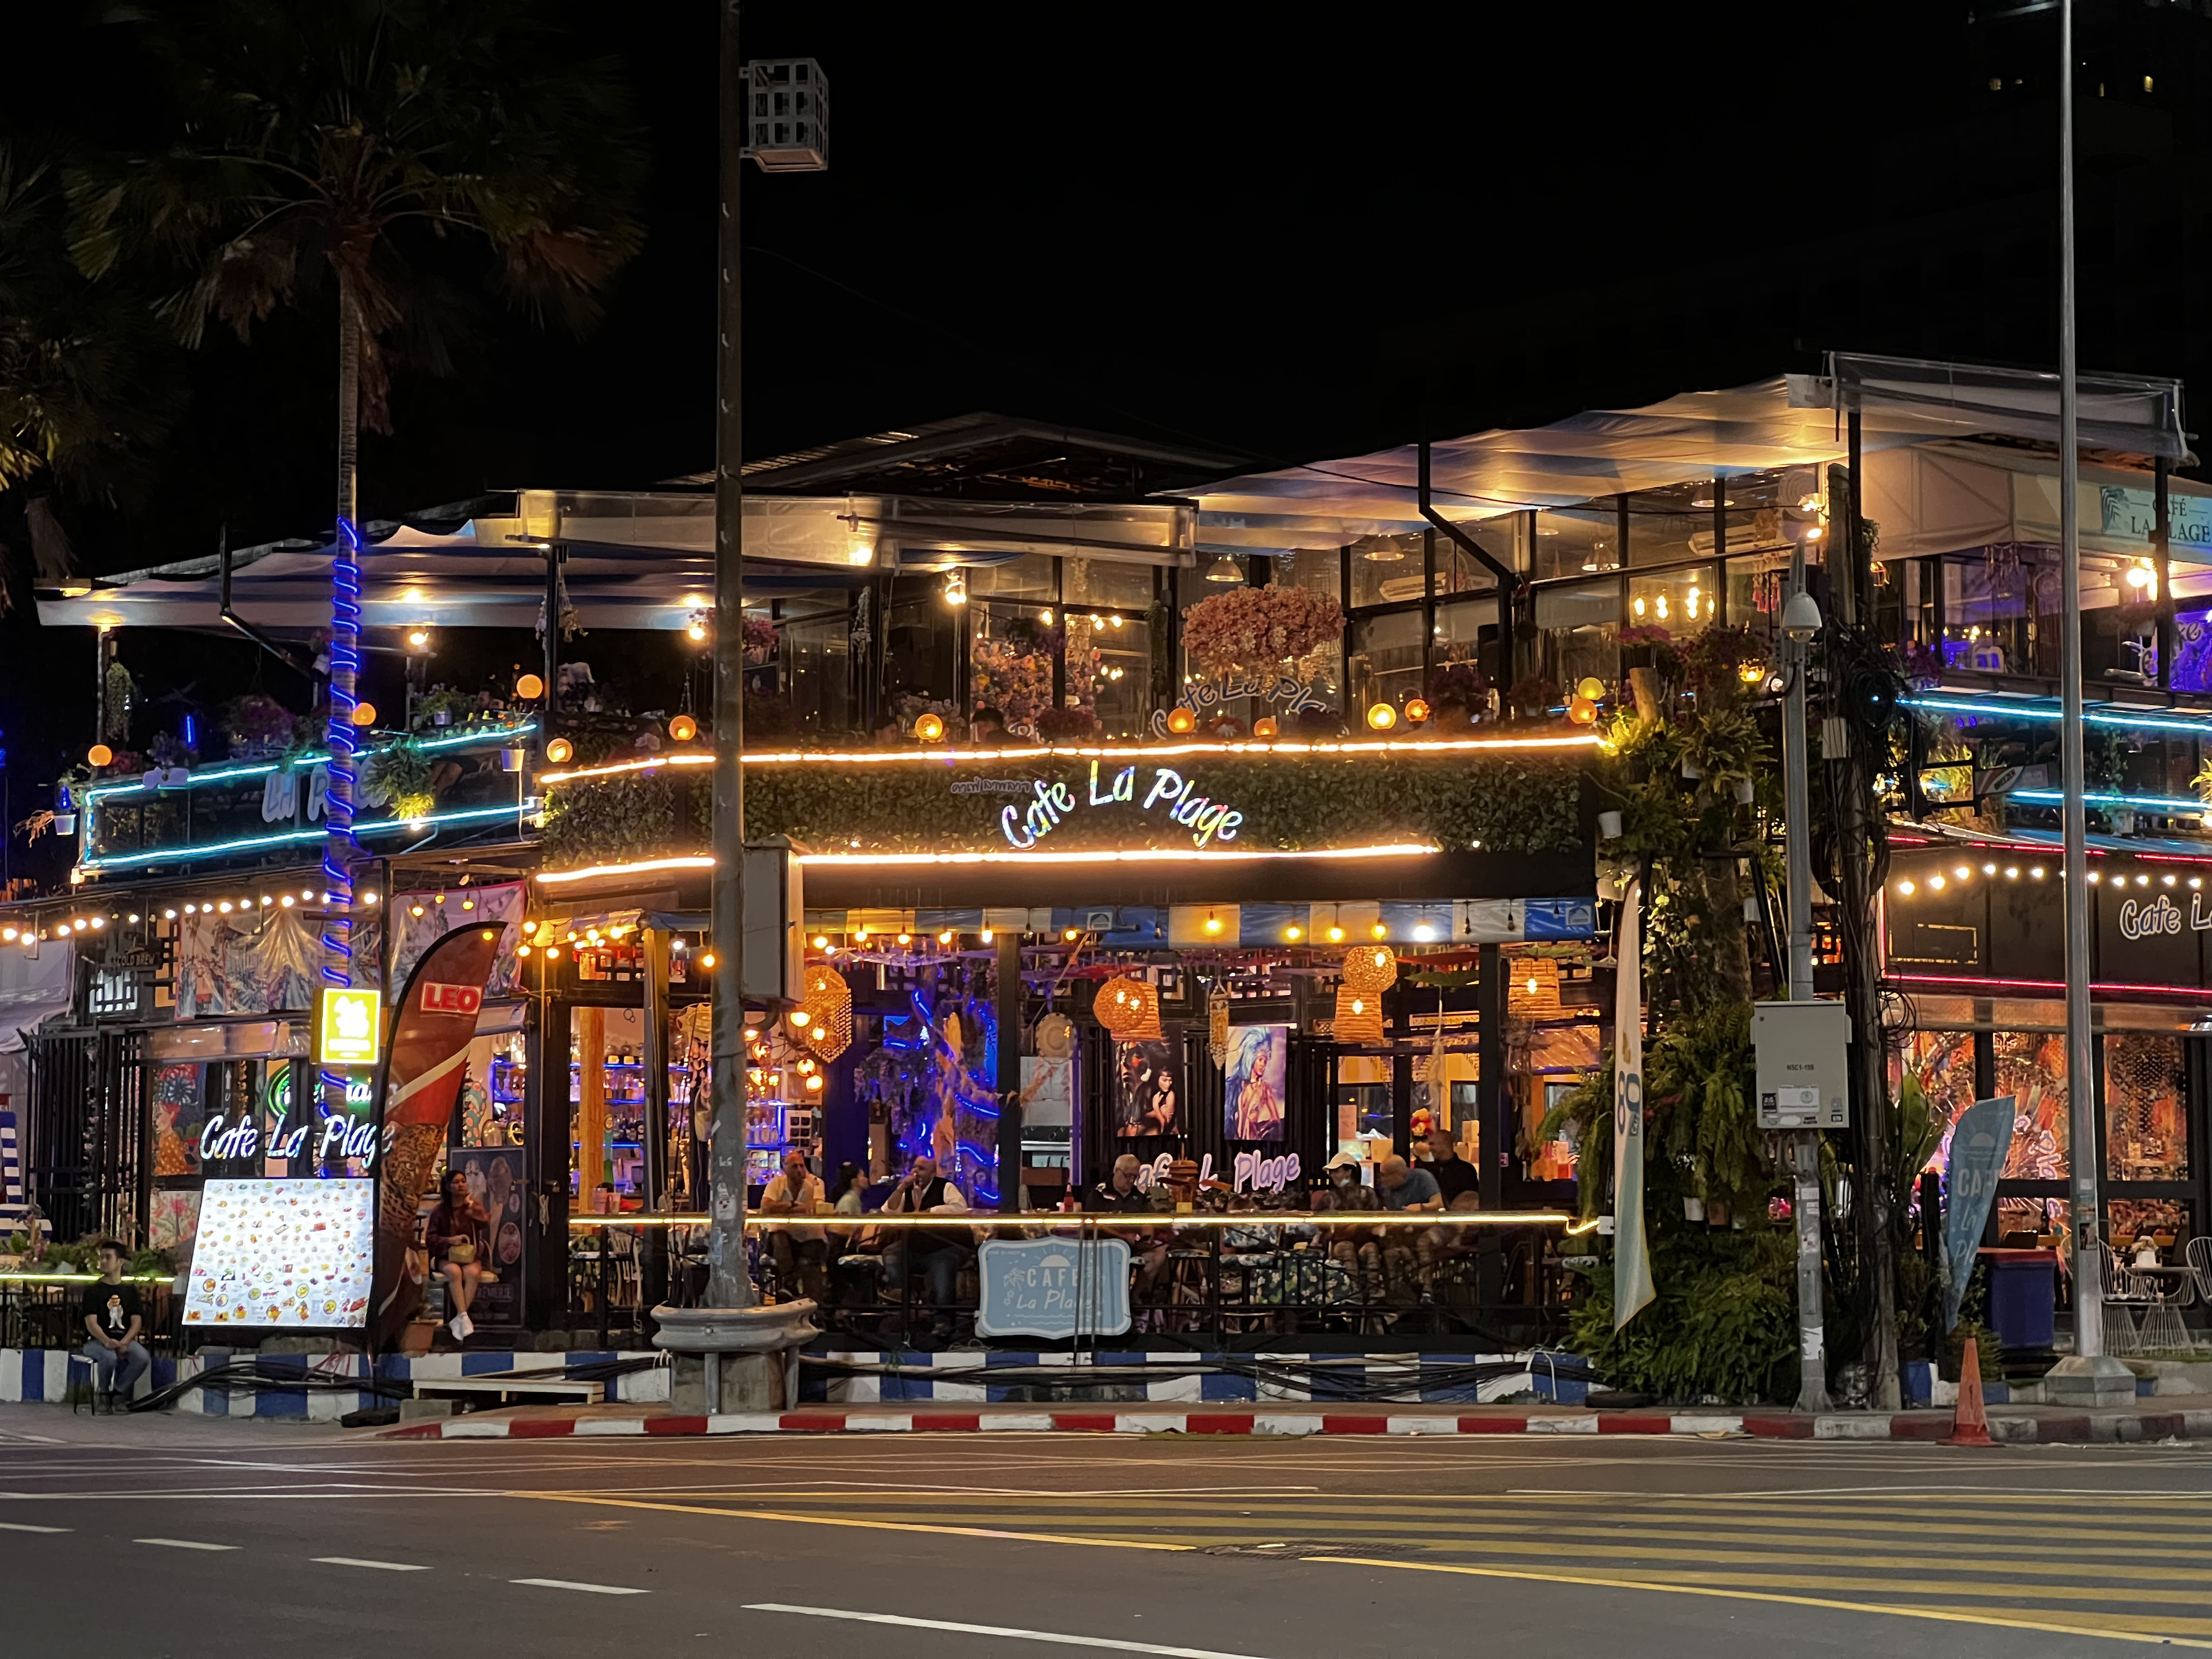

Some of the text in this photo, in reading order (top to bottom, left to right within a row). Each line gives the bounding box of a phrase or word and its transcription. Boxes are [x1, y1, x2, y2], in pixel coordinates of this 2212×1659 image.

[2152, 498, 2187, 517] FÉ
[2168, 521, 2211, 543] LAGE
[1001, 759, 1243, 848] Cafe La Plage
[2120, 892, 2212, 940] Cafe L
[424, 984, 480, 1013] LEO
[200, 1114, 395, 1169] Cafe La Plage
[1234, 1149, 1301, 1194] Plage
[1016, 1294, 1037, 1309] La
